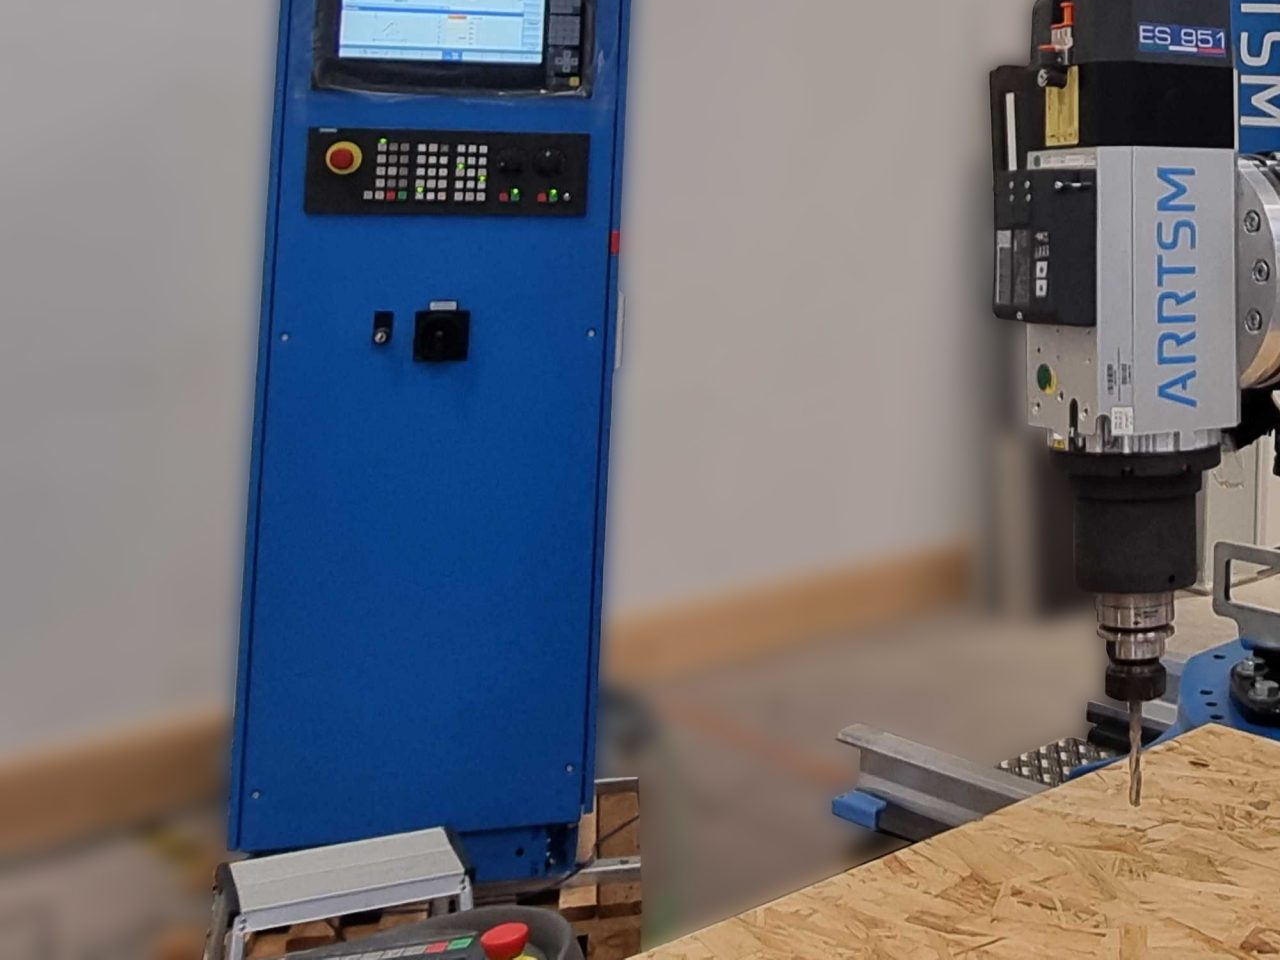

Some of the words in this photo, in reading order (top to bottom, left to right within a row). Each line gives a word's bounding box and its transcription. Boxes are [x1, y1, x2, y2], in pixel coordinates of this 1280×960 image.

[1139, 24, 1171, 45] ES
[1180, 29, 1225, 49] 951
[1156, 166, 1197, 408] ARRTSM
